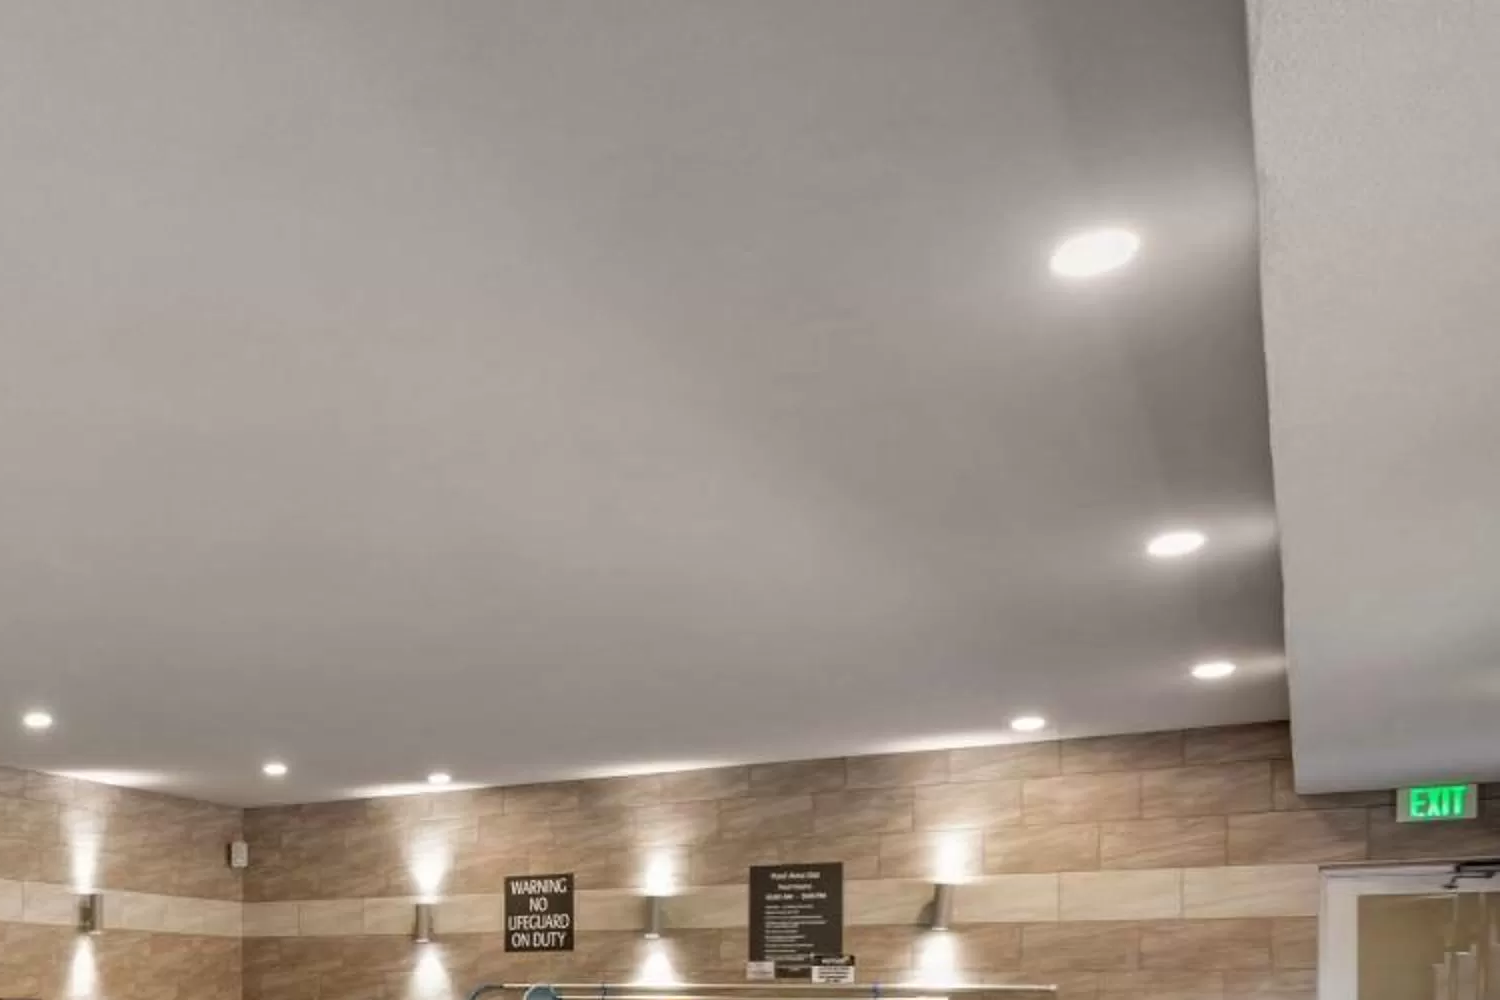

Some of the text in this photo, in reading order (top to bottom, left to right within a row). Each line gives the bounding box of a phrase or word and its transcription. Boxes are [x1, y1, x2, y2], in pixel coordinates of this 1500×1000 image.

[1411, 785, 1467, 817] EXIT
[510, 877, 567, 895] WARNING
[529, 896, 549, 912] NO
[507, 912, 571, 931] LIFEGUARD
[511, 931, 567, 948] ON DUTY
